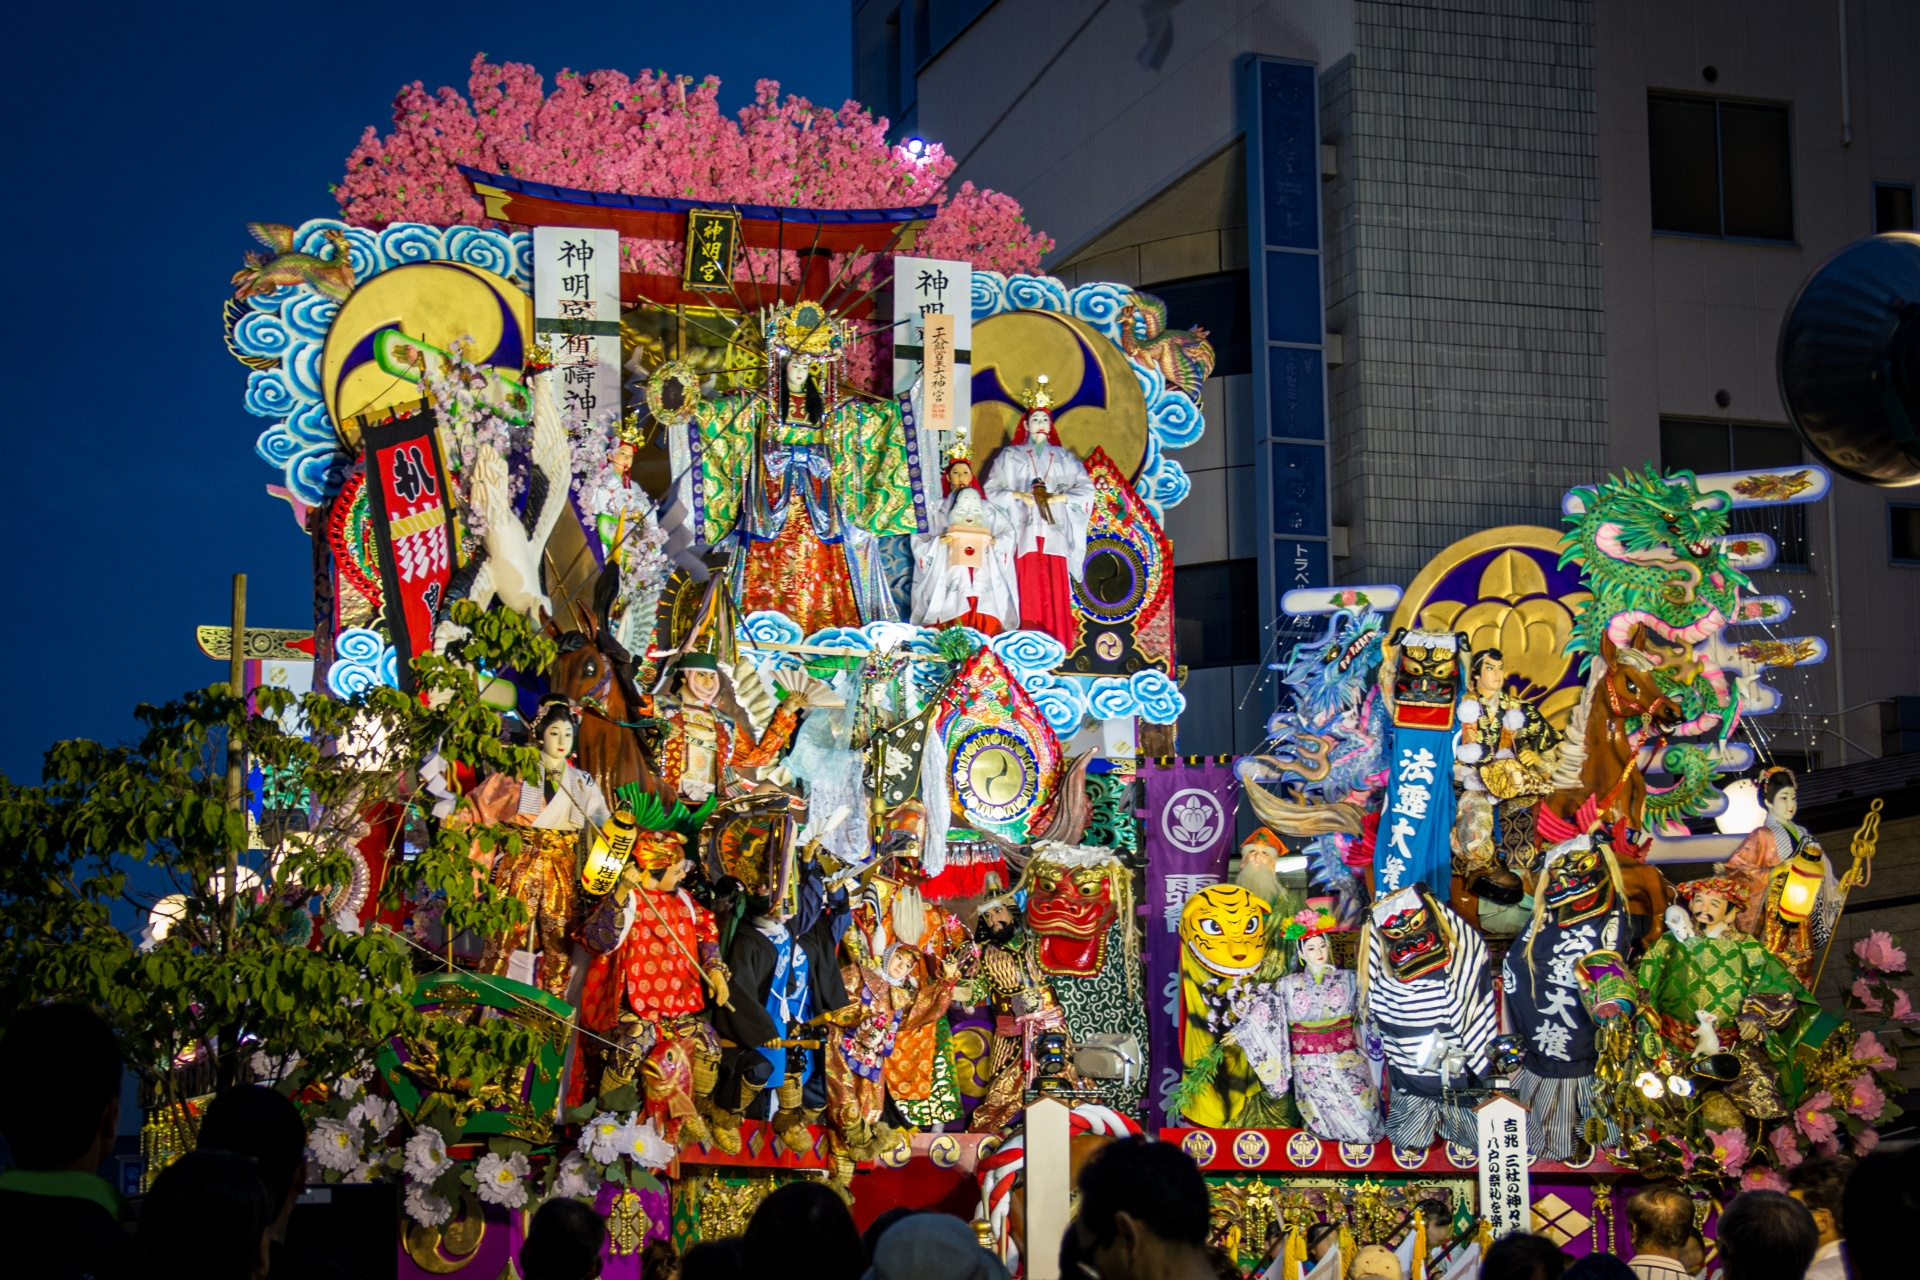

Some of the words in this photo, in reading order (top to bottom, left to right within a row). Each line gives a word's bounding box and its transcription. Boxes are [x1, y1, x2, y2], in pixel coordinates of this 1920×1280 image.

[699, 220, 724, 282] 神明宮
[1294, 544, 1310, 589] トラベ
[1503, 1118, 1519, 1148] 吉兆
